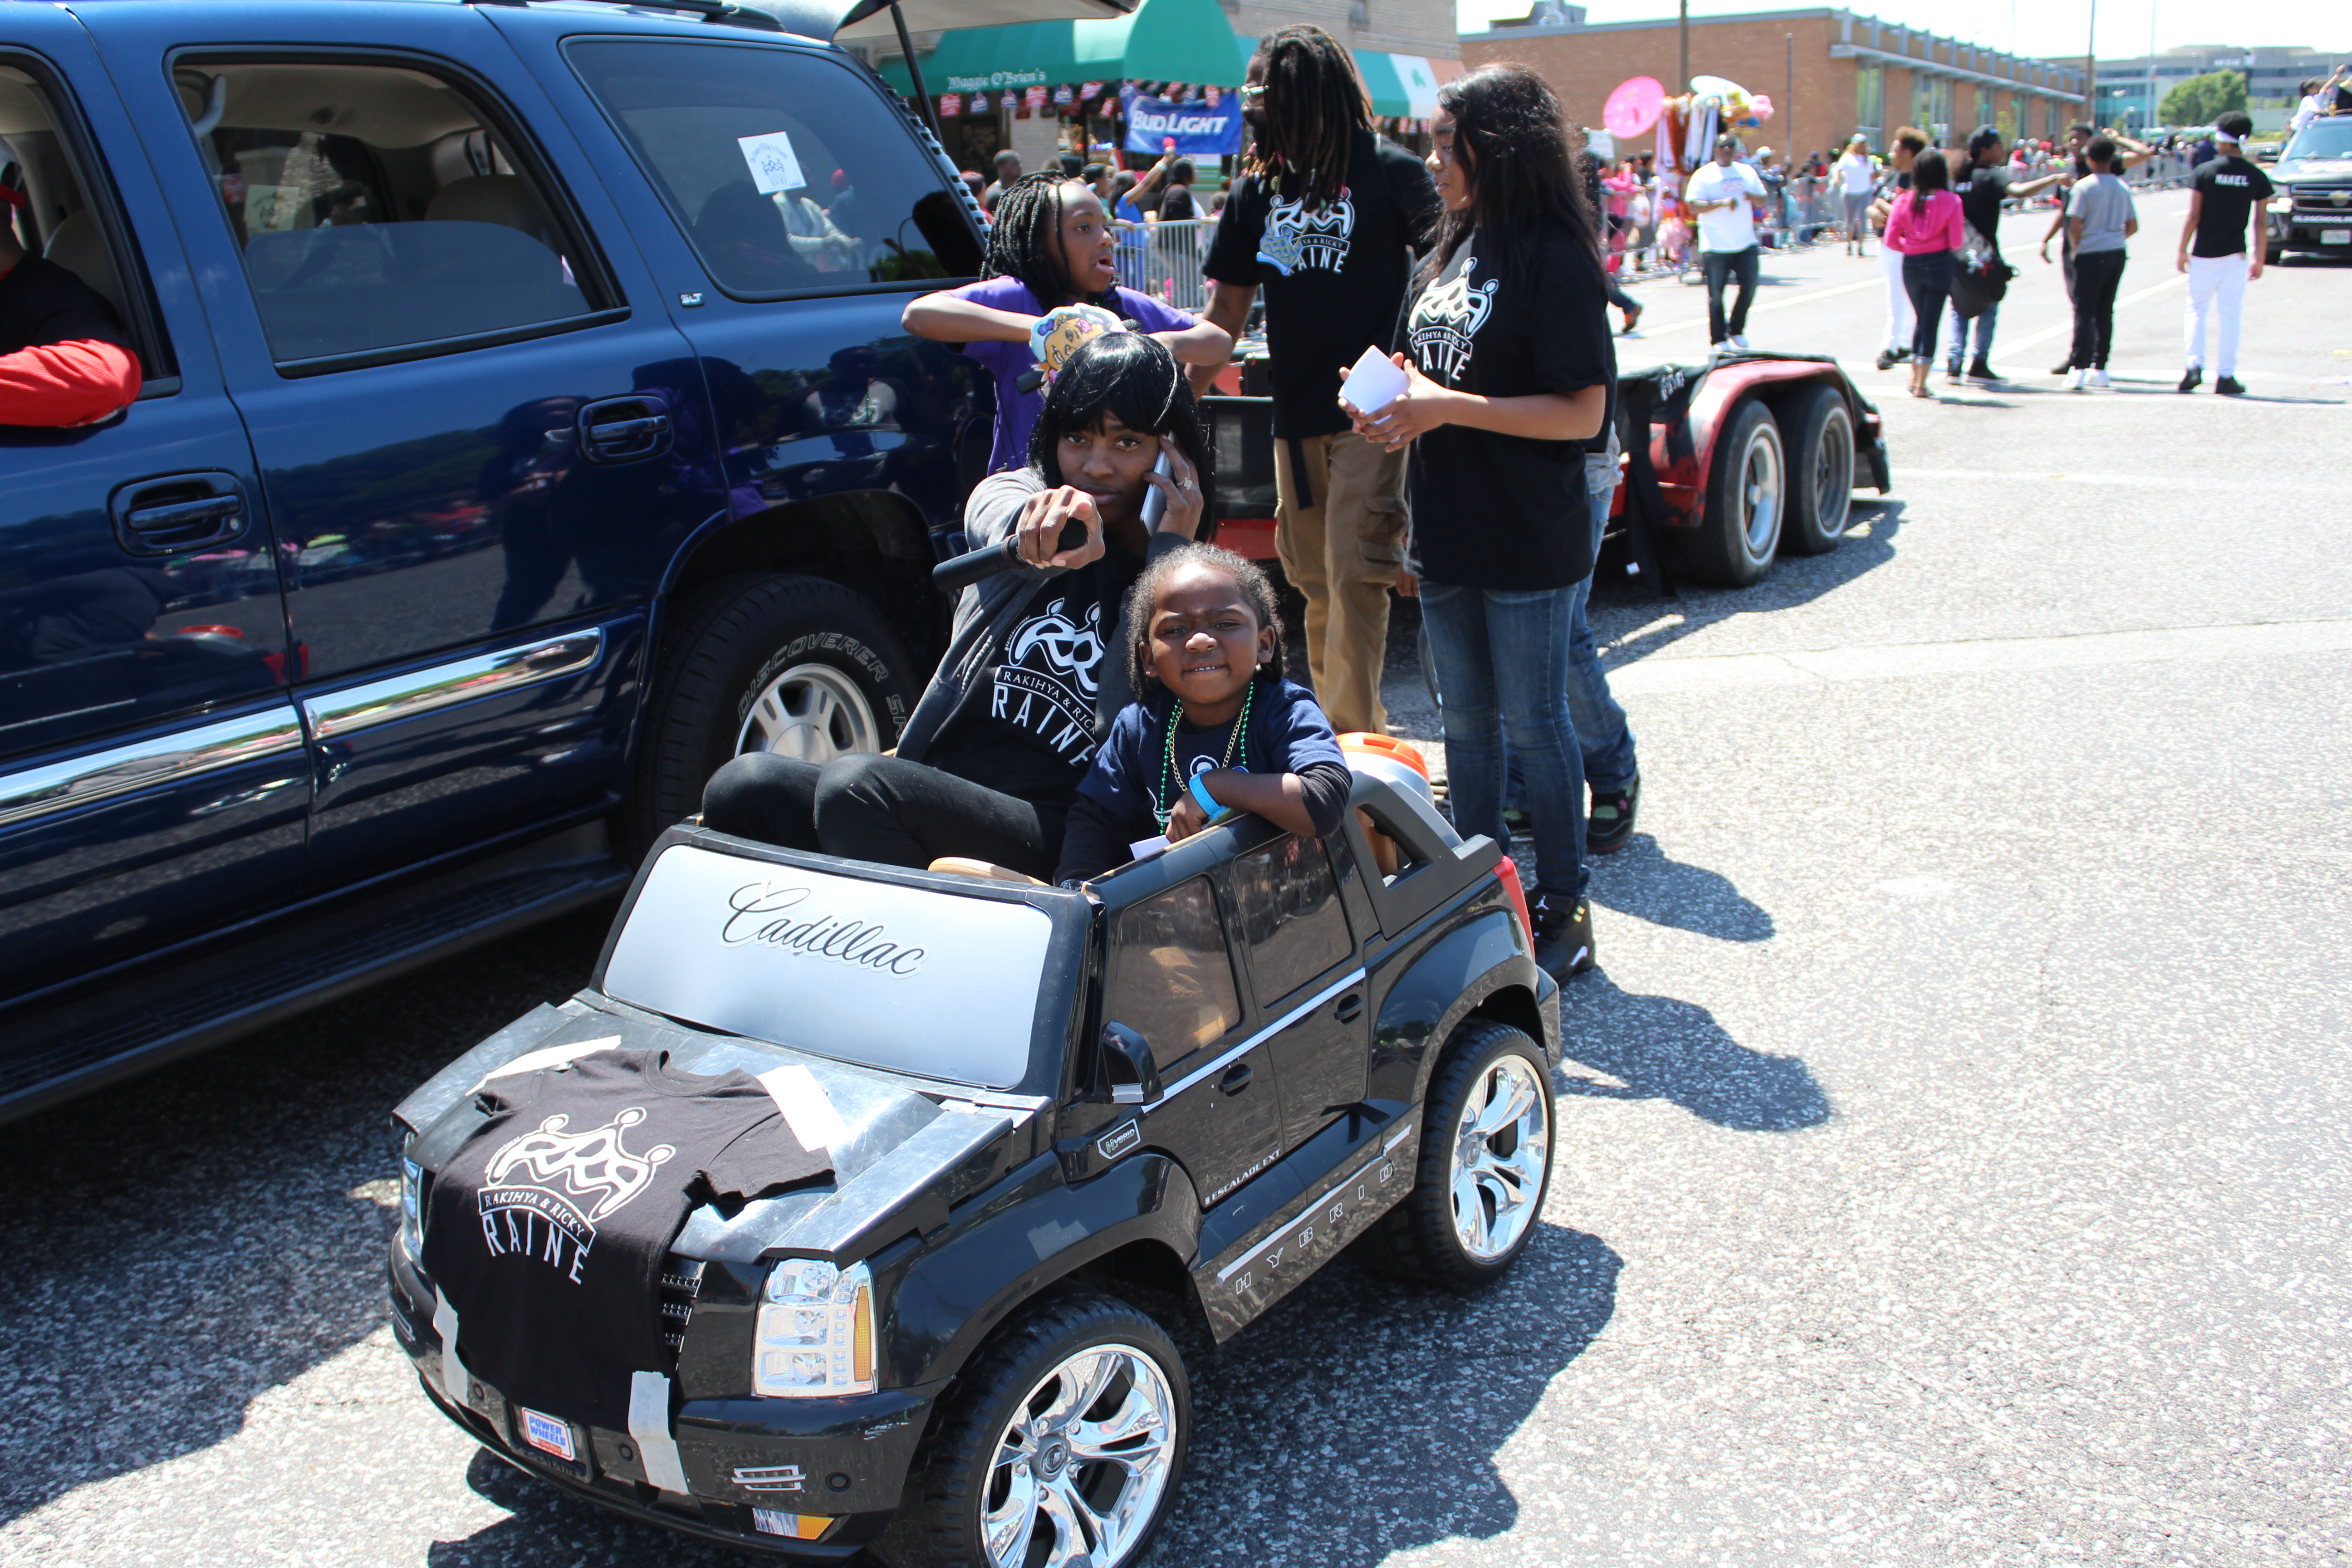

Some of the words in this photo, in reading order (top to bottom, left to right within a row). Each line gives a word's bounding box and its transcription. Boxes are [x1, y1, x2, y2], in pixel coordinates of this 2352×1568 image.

[947, 74, 989, 91] Maggie
[991, 68, 1047, 86] O'Brien's
[1288, 247, 1347, 276] AINE
[1320, 238, 1343, 248] RICKY
[681, 293, 702, 304] SLT
[1414, 331, 1441, 345] RKIHYA
[1446, 333, 1467, 349] RICKY
[1423, 343, 1470, 380] AINE
[738, 632, 889, 722] DISCOVERER
[1004, 671, 1059, 699] RAKIHYA
[1063, 698, 1071, 708] &
[1073, 707, 1096, 735] RICK
[992, 684, 1096, 767] RAINE
[722, 881, 924, 974] Cadillac
[1212, 1162, 1261, 1200] ESCALADE
[1263, 1148, 1281, 1166] EXT
[485, 1191, 539, 1207] RAKIHYA
[539, 1197, 551, 1209] &
[549, 1202, 584, 1237] RICKY
[1236, 1162, 1393, 1294] HYBRID
[482, 1209, 588, 1284] RAINE
[529, 1416, 562, 1436] POWER
[530, 1424, 566, 1446] WHEELS
